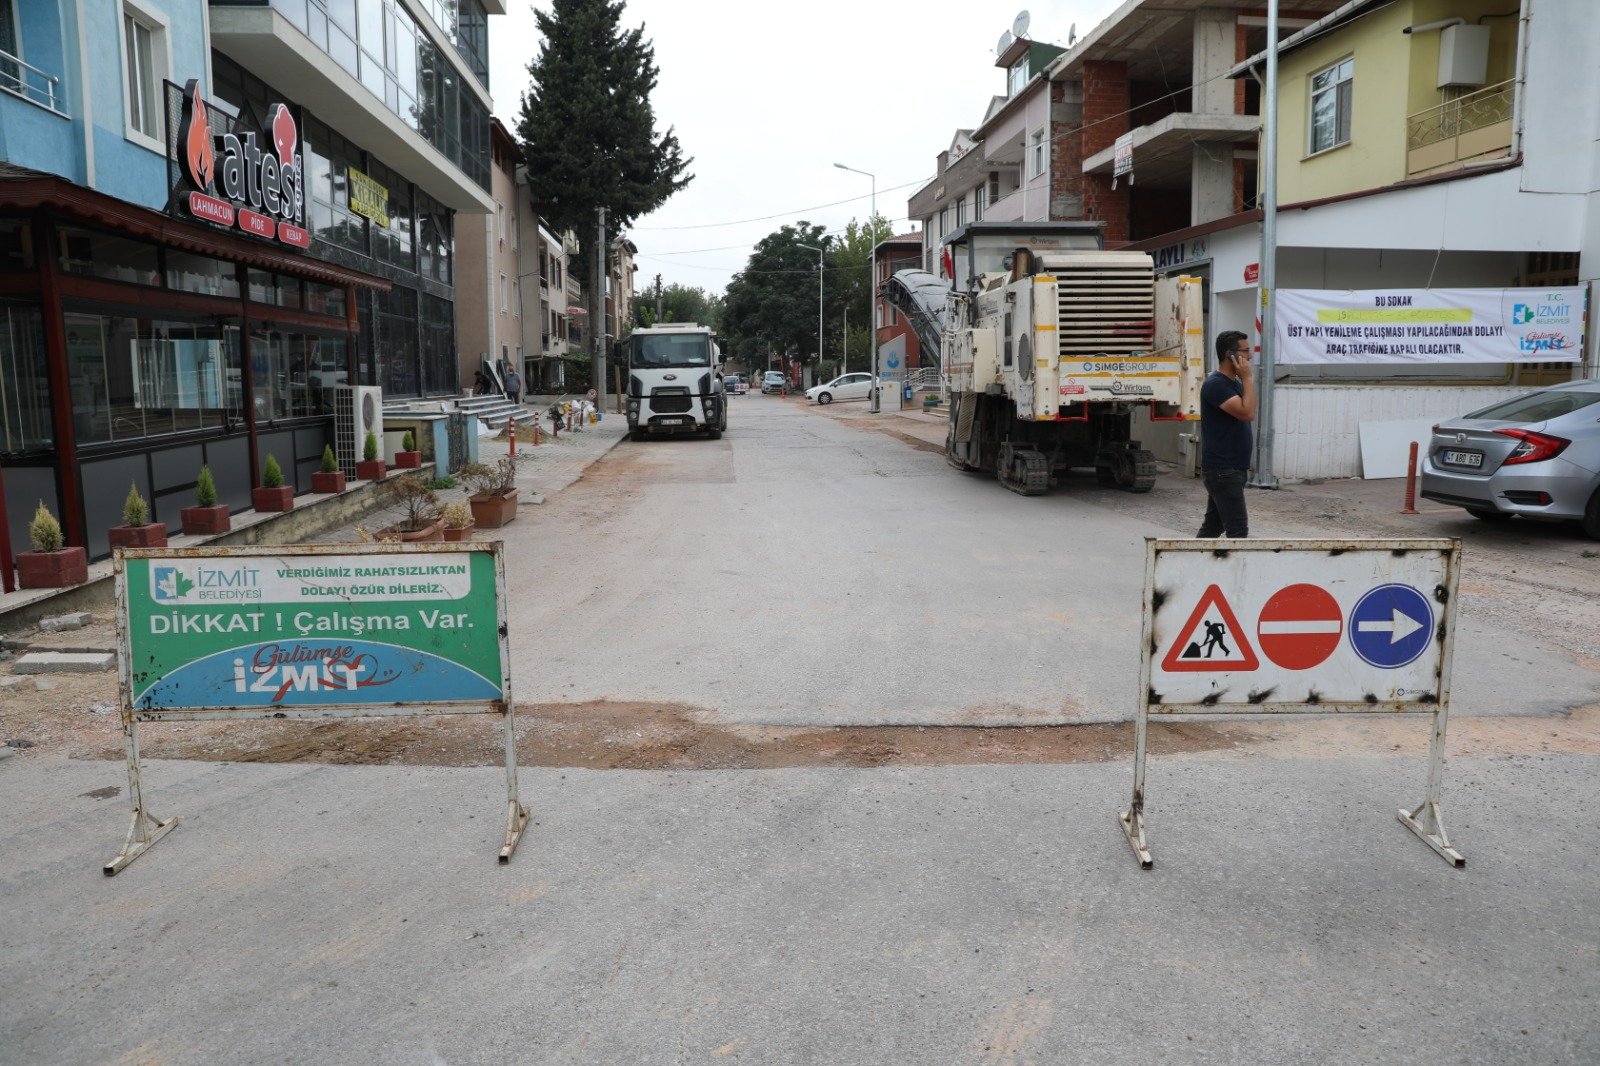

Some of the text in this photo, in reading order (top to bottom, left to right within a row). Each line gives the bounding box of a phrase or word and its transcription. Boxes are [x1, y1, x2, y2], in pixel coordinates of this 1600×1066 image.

[192, 196, 233, 219] LAHMACUN
[250, 217, 265, 231] PİDE
[1375, 295, 1413, 307] BU SOKAK
[1547, 293, 1564, 302] T.C.
[1536, 303, 1571, 317] İZMİT
[1287, 324, 1503, 339] ÜST YAPI YENİLEME ÇALIŞMASI YAPILACAĞINDAN DOLAYI
[1326, 342, 1464, 356] ARAÇ TRAFİĞİNE KAPALI OLACAKTIR.
[1123, 384, 1152, 392] Wirtgen
[198, 566, 260, 588] İZMİT
[276, 565, 466, 578] VERDİĞİMİZ RAHATSIZLIKTAN
[199, 588, 263, 600] BELEDİYESİ
[301, 583, 444, 596] DOLAYI ÖZÜR DİLERİZ.
[150, 610, 265, 634] DİKKAT
[293, 612, 410, 636] Çalışma
[418, 609, 474, 629] Var.
[252, 643, 355, 675] Gülümse
[233, 657, 366, 693] İZMİT
